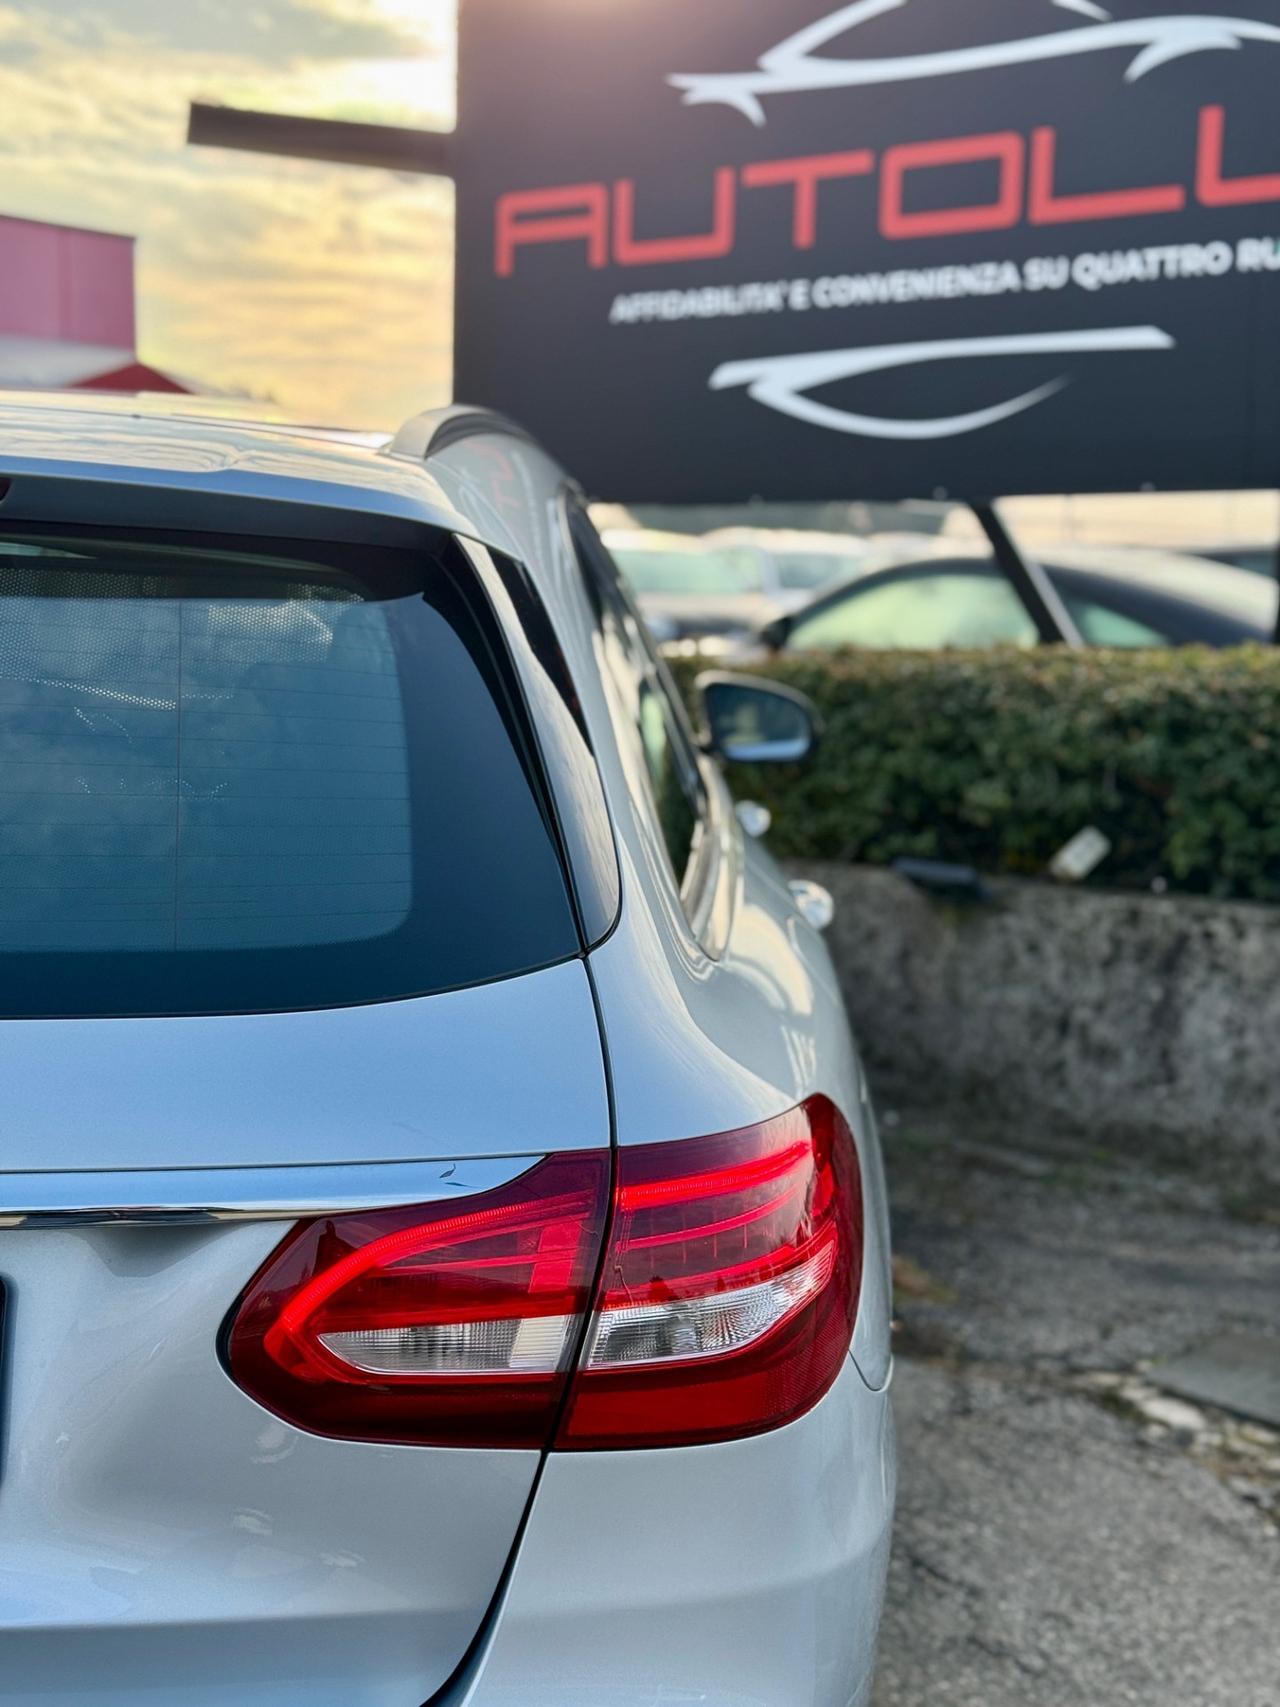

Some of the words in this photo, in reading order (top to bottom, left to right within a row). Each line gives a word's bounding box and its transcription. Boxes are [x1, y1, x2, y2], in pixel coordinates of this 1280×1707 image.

[788, 278, 810, 311] E
[811, 261, 1022, 308] CONVENIENZA
[1023, 256, 1070, 291] SU
[1070, 241, 1234, 290] QUATTRO
